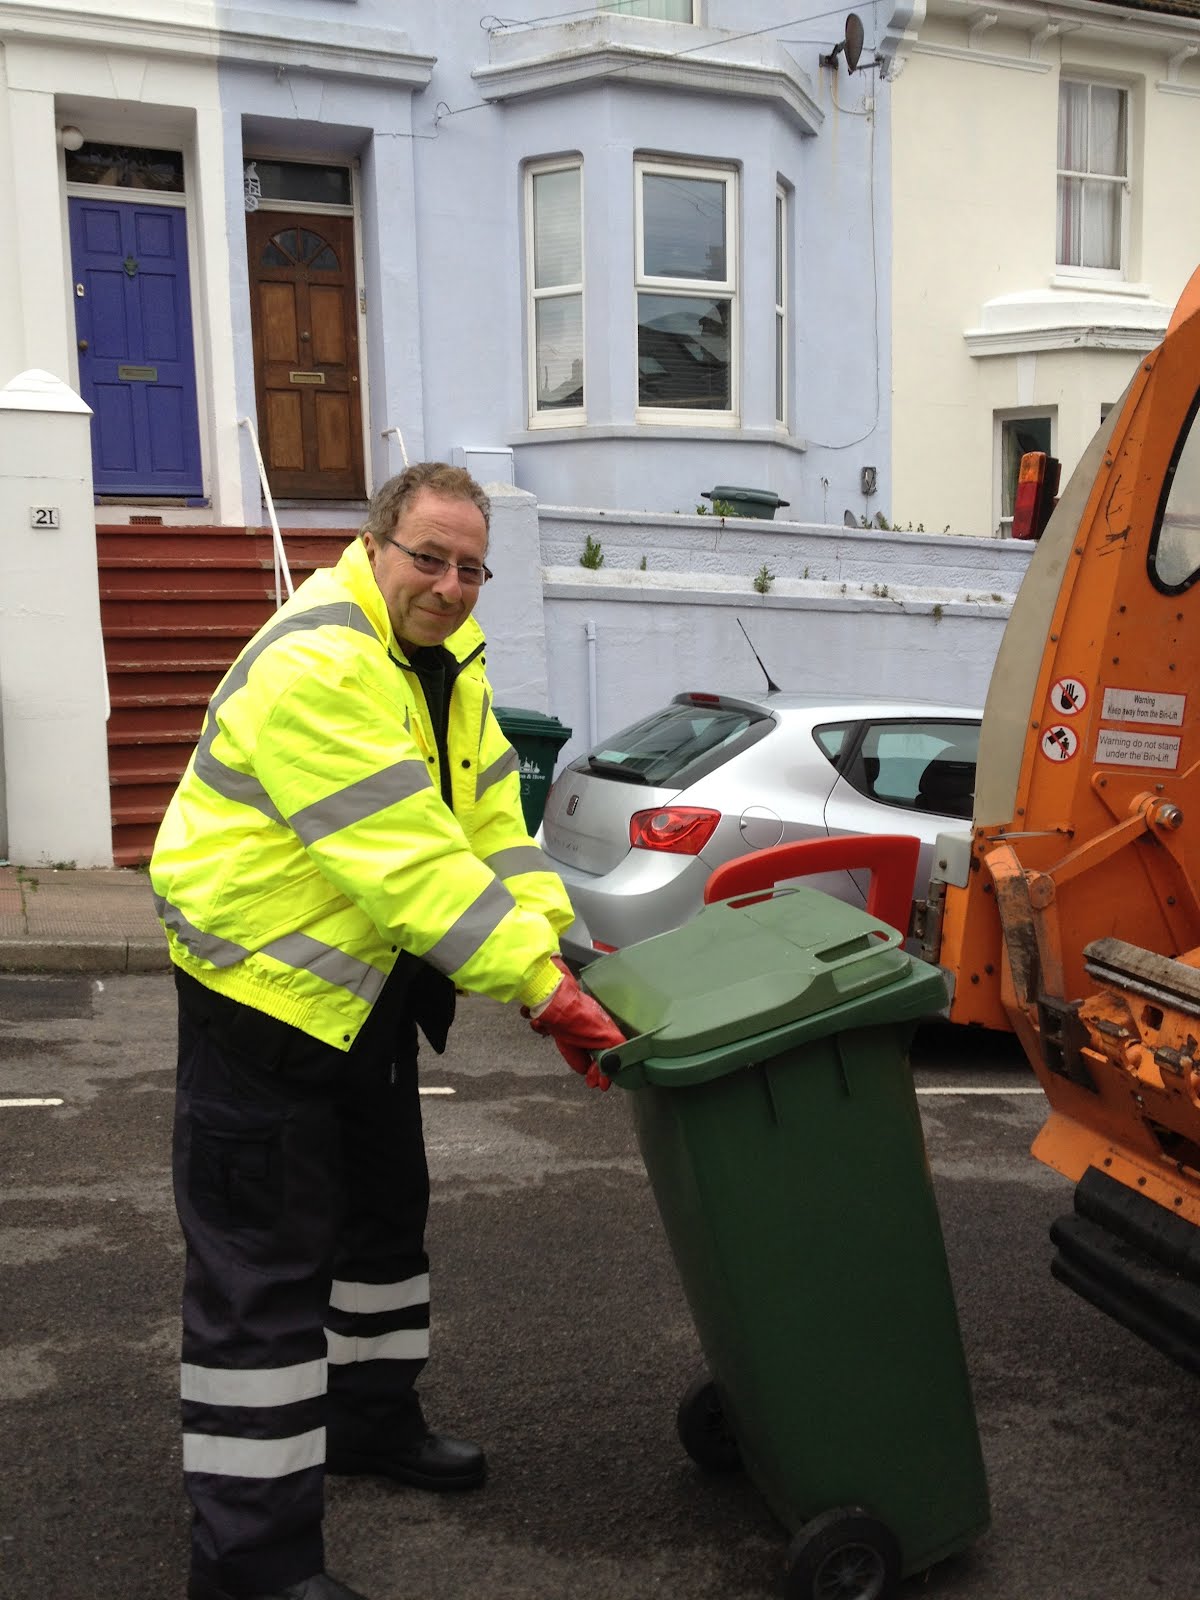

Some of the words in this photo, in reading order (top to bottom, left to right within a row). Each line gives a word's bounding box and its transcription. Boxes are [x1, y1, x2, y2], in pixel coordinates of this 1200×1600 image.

[36, 509, 54, 525] 21
[1134, 695, 1155, 707] Warning
[1107, 705, 1121, 715] Keep
[1122, 708, 1136, 717] away
[1137, 708, 1149, 717] from
[1149, 710, 1158, 718] the
[1100, 736, 1131, 748] Warning
[1133, 739, 1142, 748] do
[1144, 741, 1156, 749] not
[1158, 742, 1178, 751] stand
[1106, 750, 1128, 759] under
[1129, 751, 1141, 760] the
